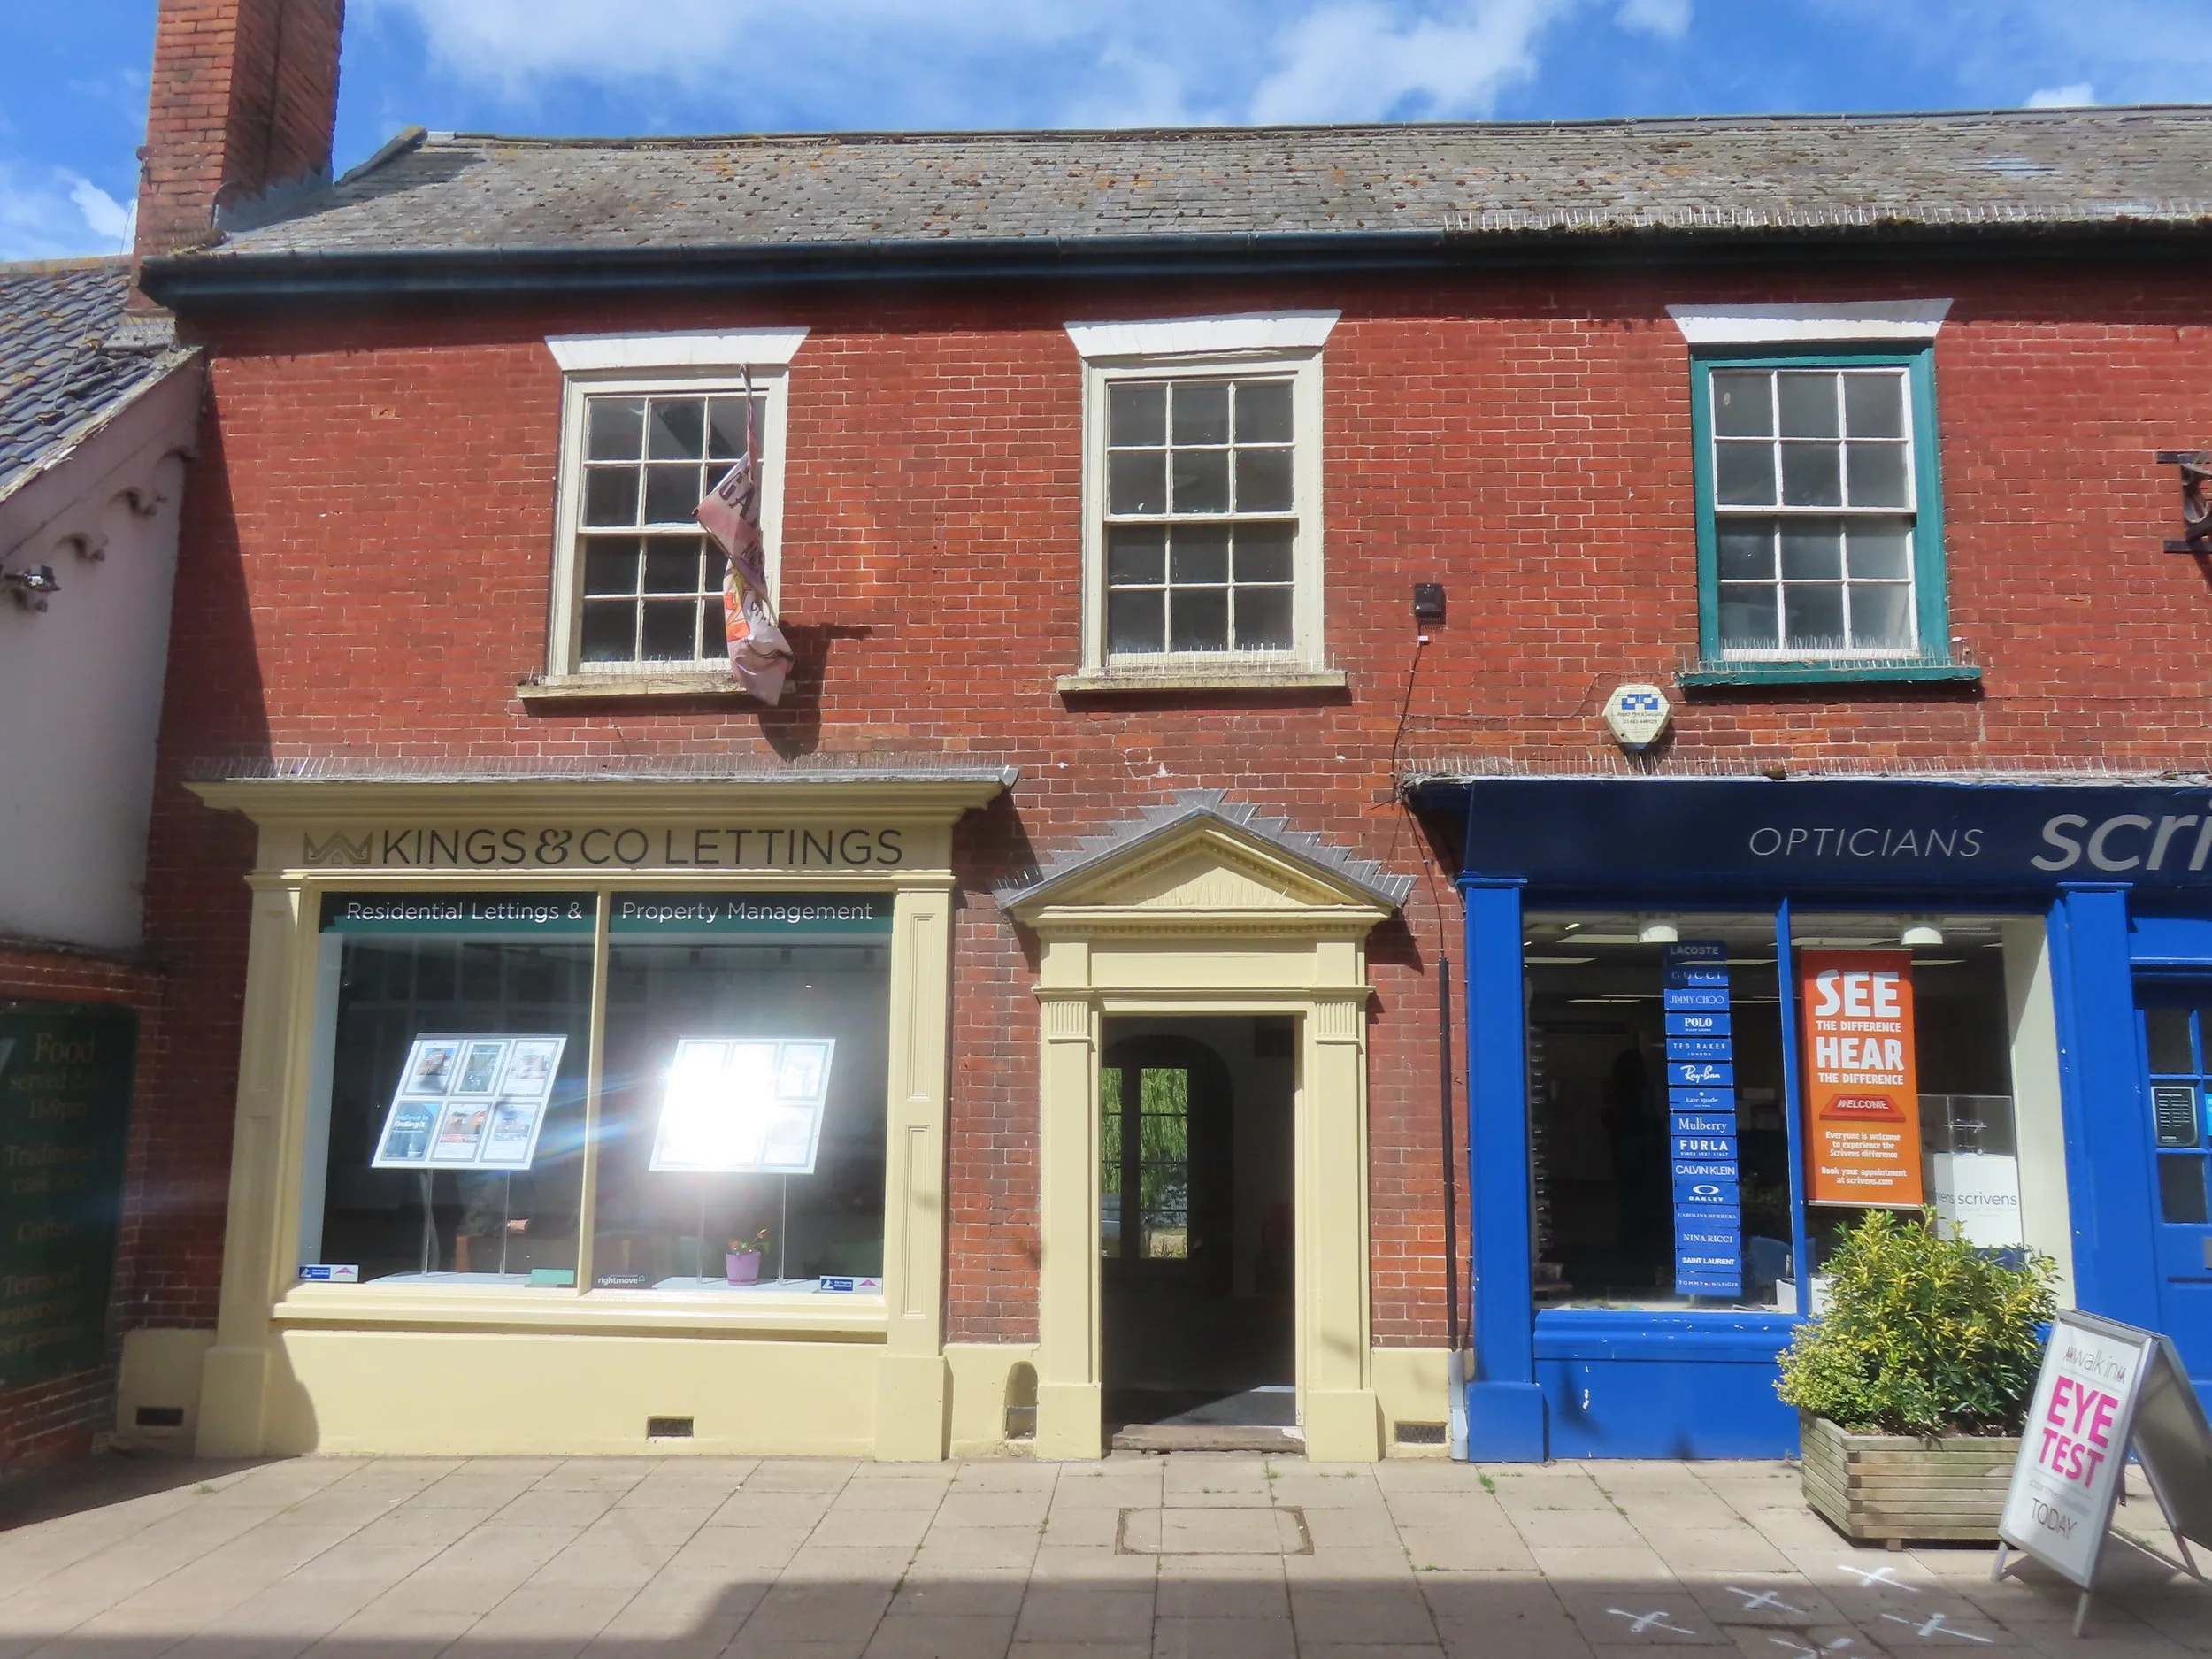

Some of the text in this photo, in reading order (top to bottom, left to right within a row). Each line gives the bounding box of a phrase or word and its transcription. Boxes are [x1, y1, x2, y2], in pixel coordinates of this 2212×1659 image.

[1748, 827, 1985, 857] OPTICIANS
[2031, 799, 2212, 872] scri
[665, 829, 902, 865] LETTINGS
[346, 902, 583, 924] Residential Lettings &
[622, 902, 874, 924] Property Management
[1670, 946, 1719, 955] LACOSTE
[1671, 971, 1721, 979] GUCCI
[1669, 995, 1724, 1005] JIMMY CHOO
[1815, 968, 1901, 1018] SEE
[1684, 1017, 1713, 1027] POLO
[1815, 1019, 1901, 1033] THE DIFFERENCE
[33, 1032, 96, 1064] Food
[1815, 1036, 1905, 1071] HEAR
[1679, 1064, 1721, 1084] Ray-Ban
[1817, 1072, 1904, 1086] THE DIFFERENCE
[1837, 1099, 1889, 1110] WELCOME
[1678, 1117, 1728, 1133] Mulberry
[1825, 1131, 1860, 1141] Everyone
[1870, 1133, 1901, 1141] welcome
[1679, 1139, 1729, 1151] FURLA
[1842, 1141, 1881, 1150] experience
[1829, 1148, 1899, 1158] Scrivens difference
[1675, 1164, 1736, 1176] CALVIN KLEIN
[1821, 1166, 1908, 1178] Book your appointment
[1847, 1177, 1894, 1186] scrivens.com
[1957, 1191, 2018, 1206] scrivens
[1683, 1233, 1707, 1242] NINA
[597, 1277, 638, 1286] rightmove
[2073, 1348, 2105, 1375] walk
[2046, 1374, 2120, 1449] EYE
[2039, 1427, 2105, 1489] TEST
[2031, 1496, 2078, 1540] TODAY
